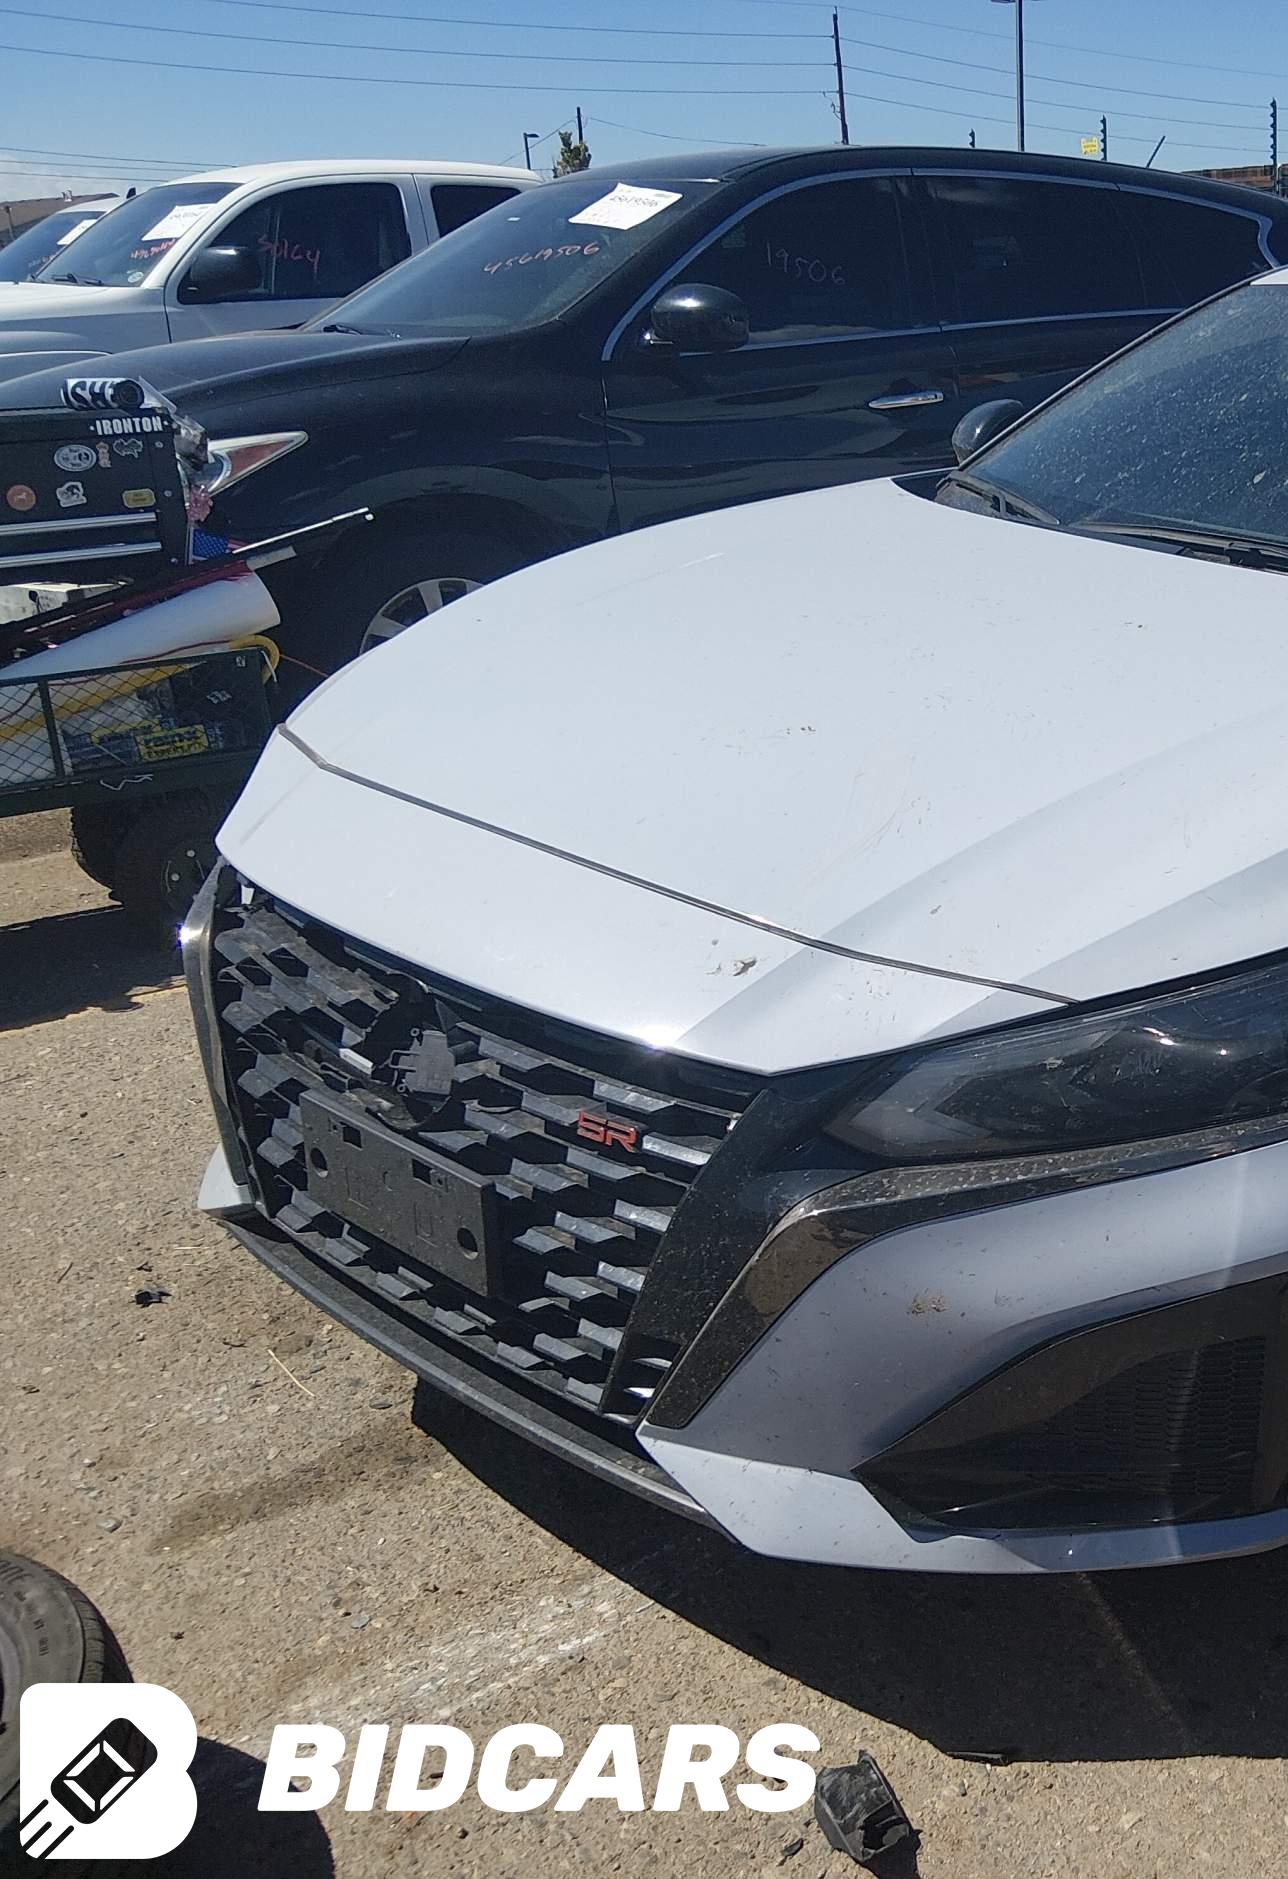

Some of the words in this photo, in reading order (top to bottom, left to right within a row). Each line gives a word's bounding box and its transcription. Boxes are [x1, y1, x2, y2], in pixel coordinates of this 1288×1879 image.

[766, 242, 846, 285] 19506
[95, 416, 163, 436] IRONTON
[577, 1110, 639, 1153] SR
